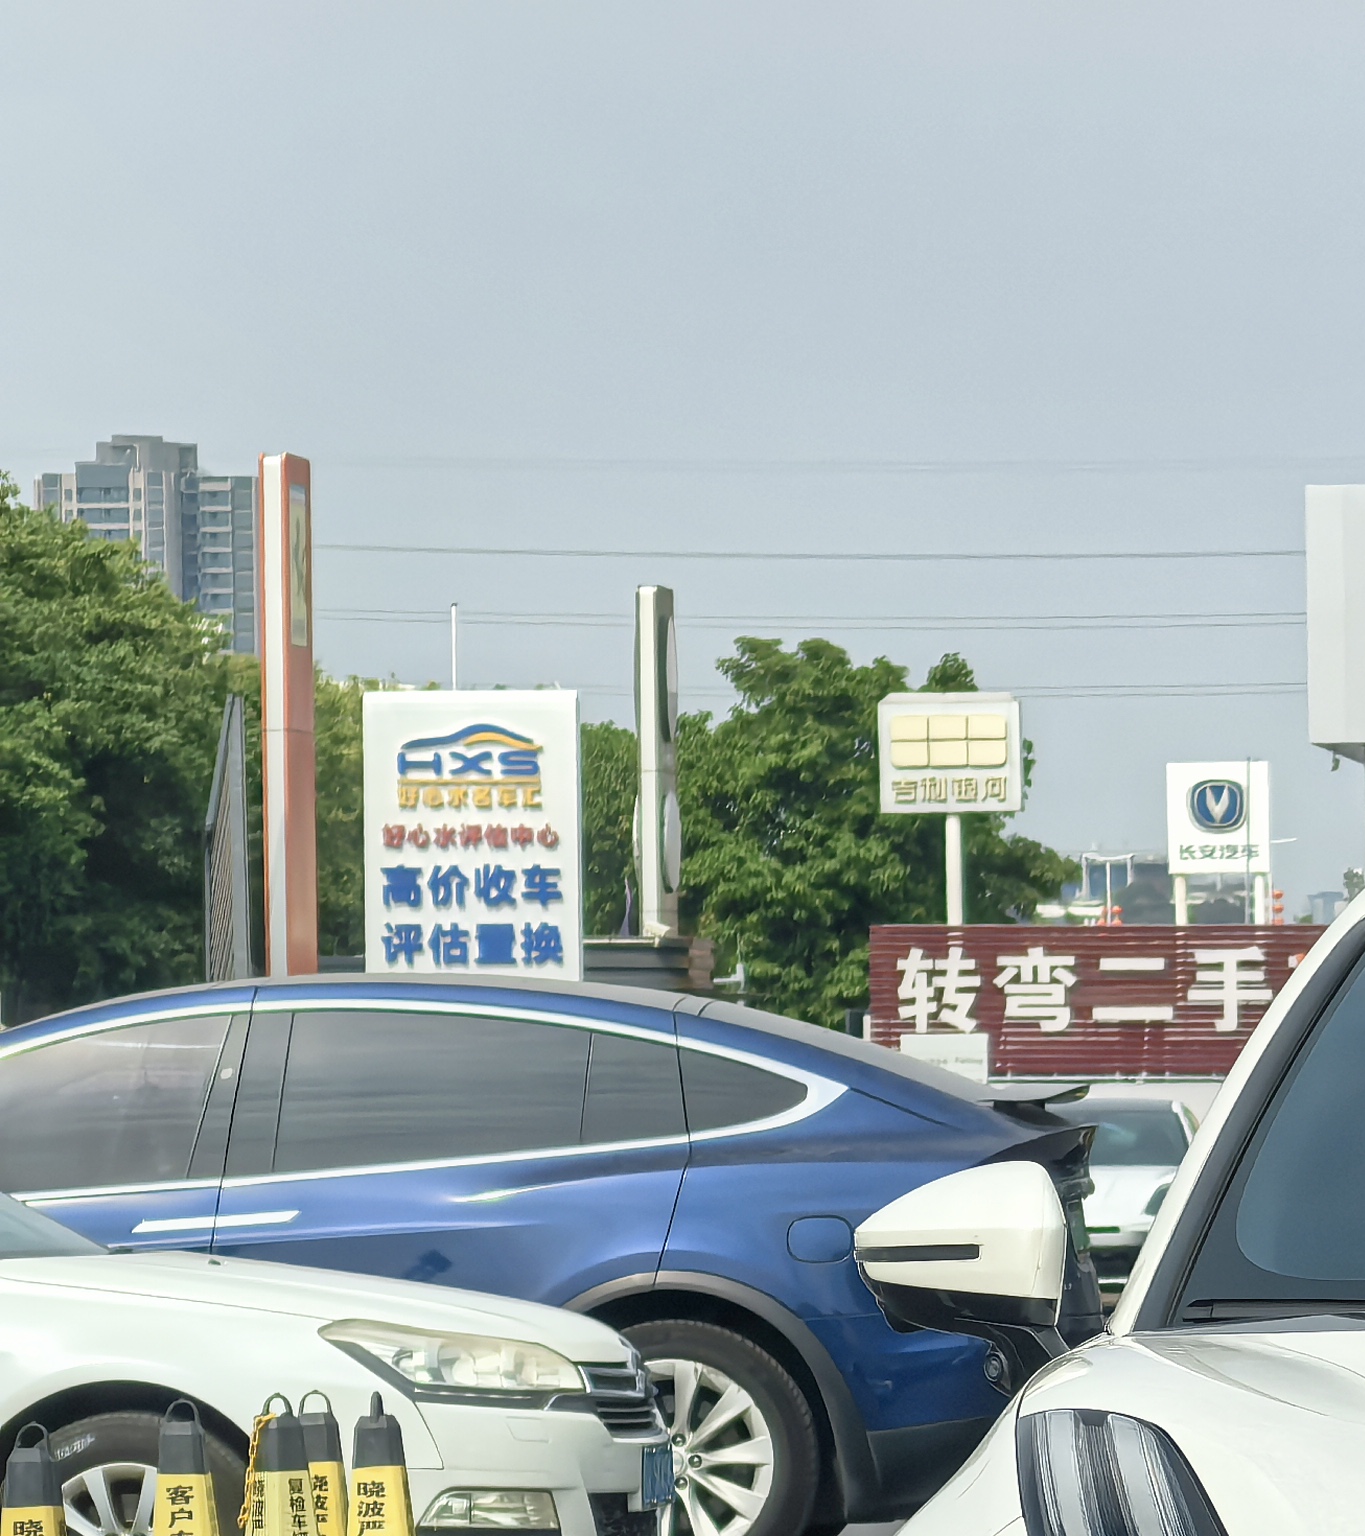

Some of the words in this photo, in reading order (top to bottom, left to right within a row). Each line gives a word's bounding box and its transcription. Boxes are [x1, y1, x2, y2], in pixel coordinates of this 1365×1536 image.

[397, 751, 540, 776] HXS
[1178, 844, 1259, 860] 长安汽车
[380, 864, 563, 909] 高价收车
[380, 922, 563, 968] 评估置换
[897, 946, 1305, 1033] 转弯二手
